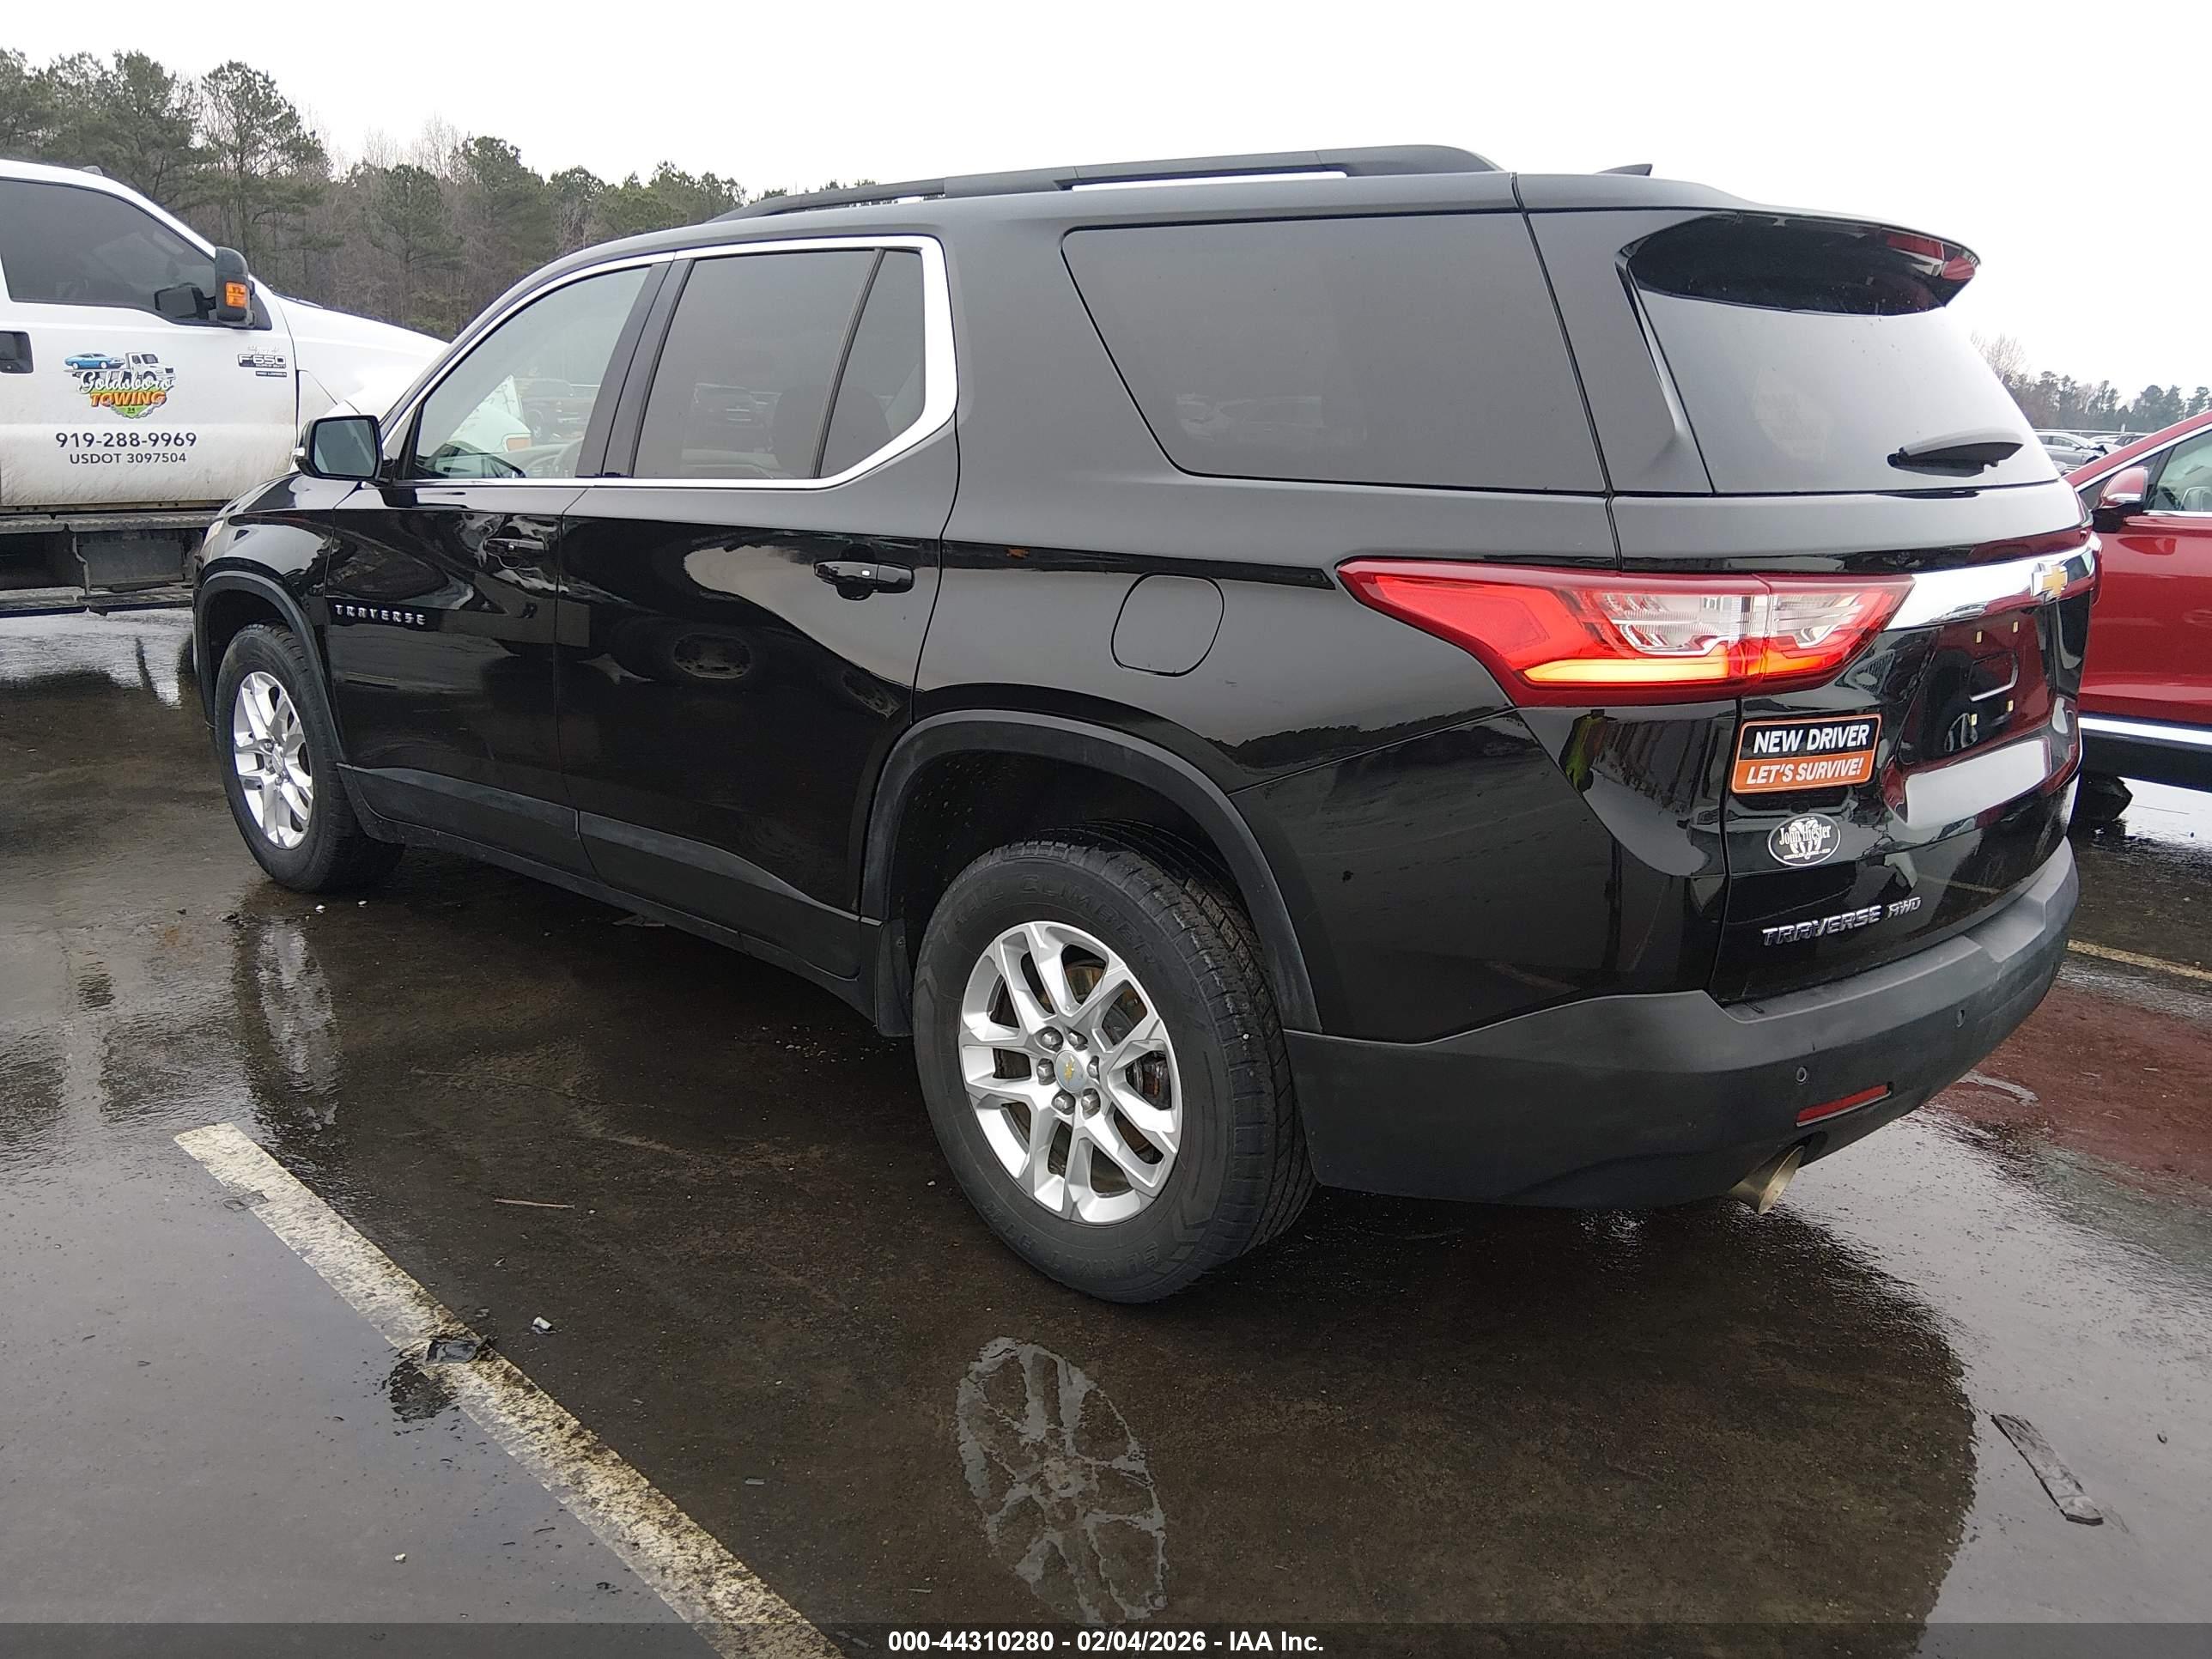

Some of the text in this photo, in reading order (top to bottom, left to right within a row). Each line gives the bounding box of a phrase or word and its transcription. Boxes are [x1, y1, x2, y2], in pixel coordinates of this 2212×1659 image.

[78, 369, 174, 394] Goldsboro
[90, 391, 167, 408] TOWING
[55, 432, 197, 448] 919-288-9969
[70, 452, 187, 465] USDOT 3097504
[335, 605, 426, 625] TRAVERSE
[1753, 724, 1870, 754] NEW DRIVER
[1746, 757, 1864, 785] LET'S SURVIVE!
[1779, 826, 1802, 846] John
[1761, 904, 1882, 946] TRAVERSE
